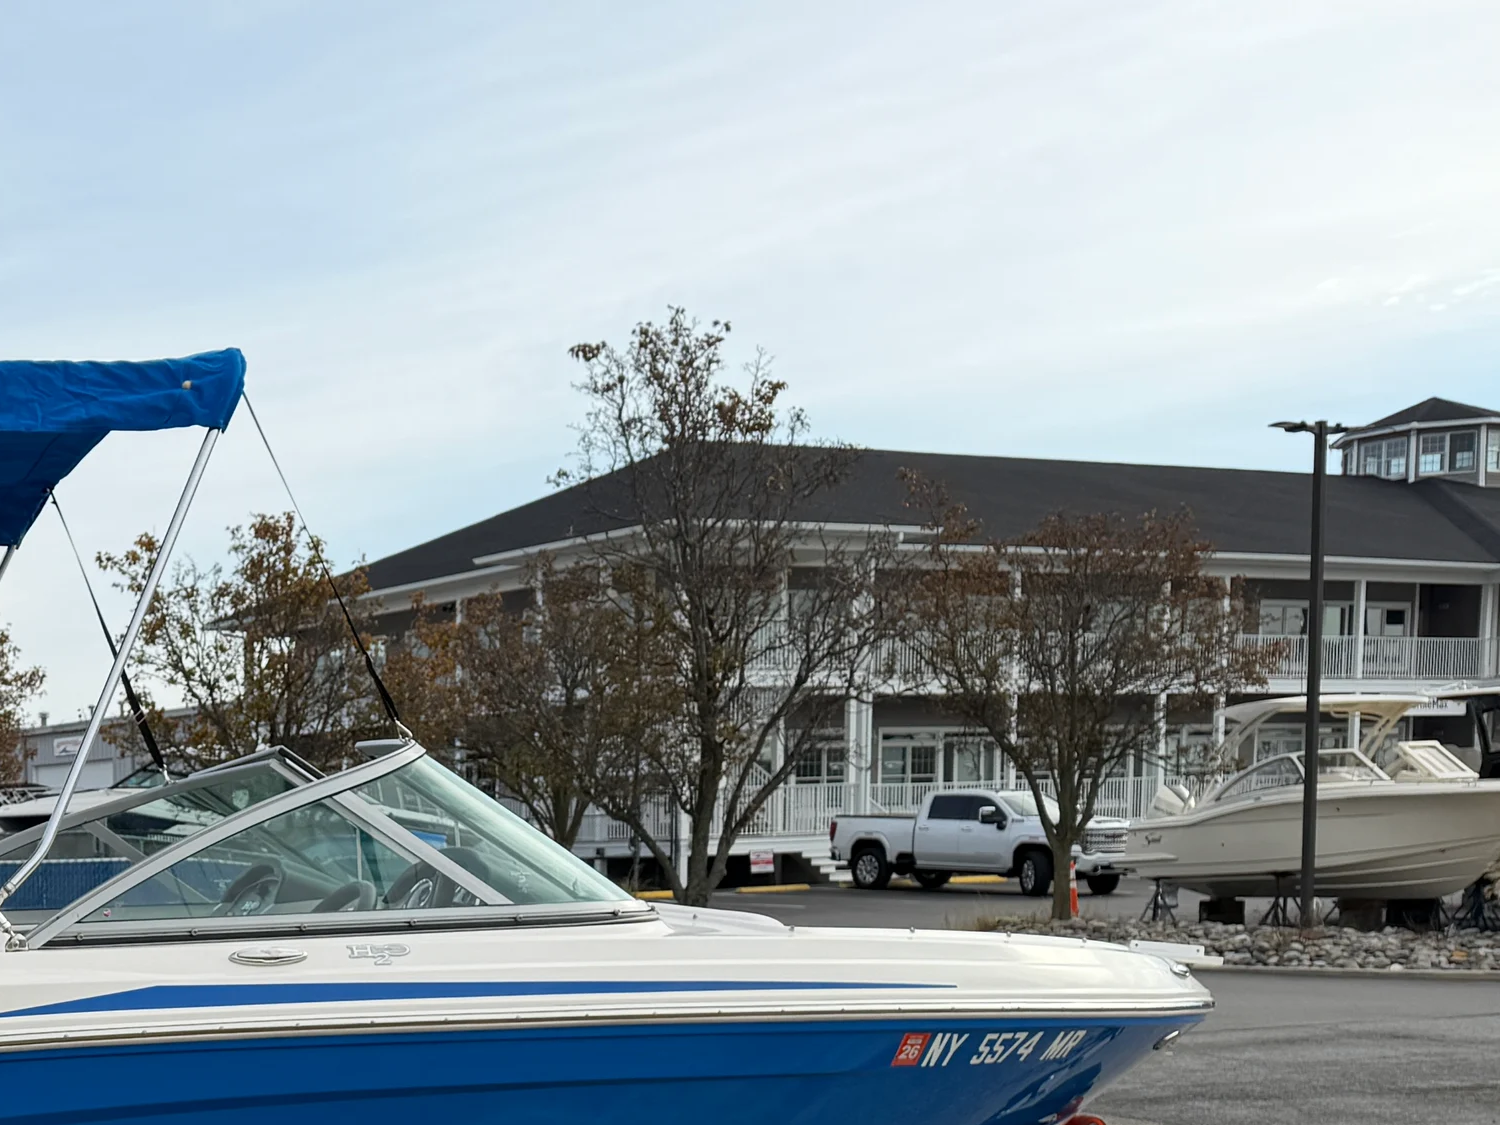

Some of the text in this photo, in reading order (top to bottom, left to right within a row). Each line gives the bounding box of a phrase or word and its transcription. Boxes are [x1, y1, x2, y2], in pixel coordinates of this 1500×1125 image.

[897, 1044, 921, 1060] 26
[920, 1029, 1088, 1067] NY 5574 MR
